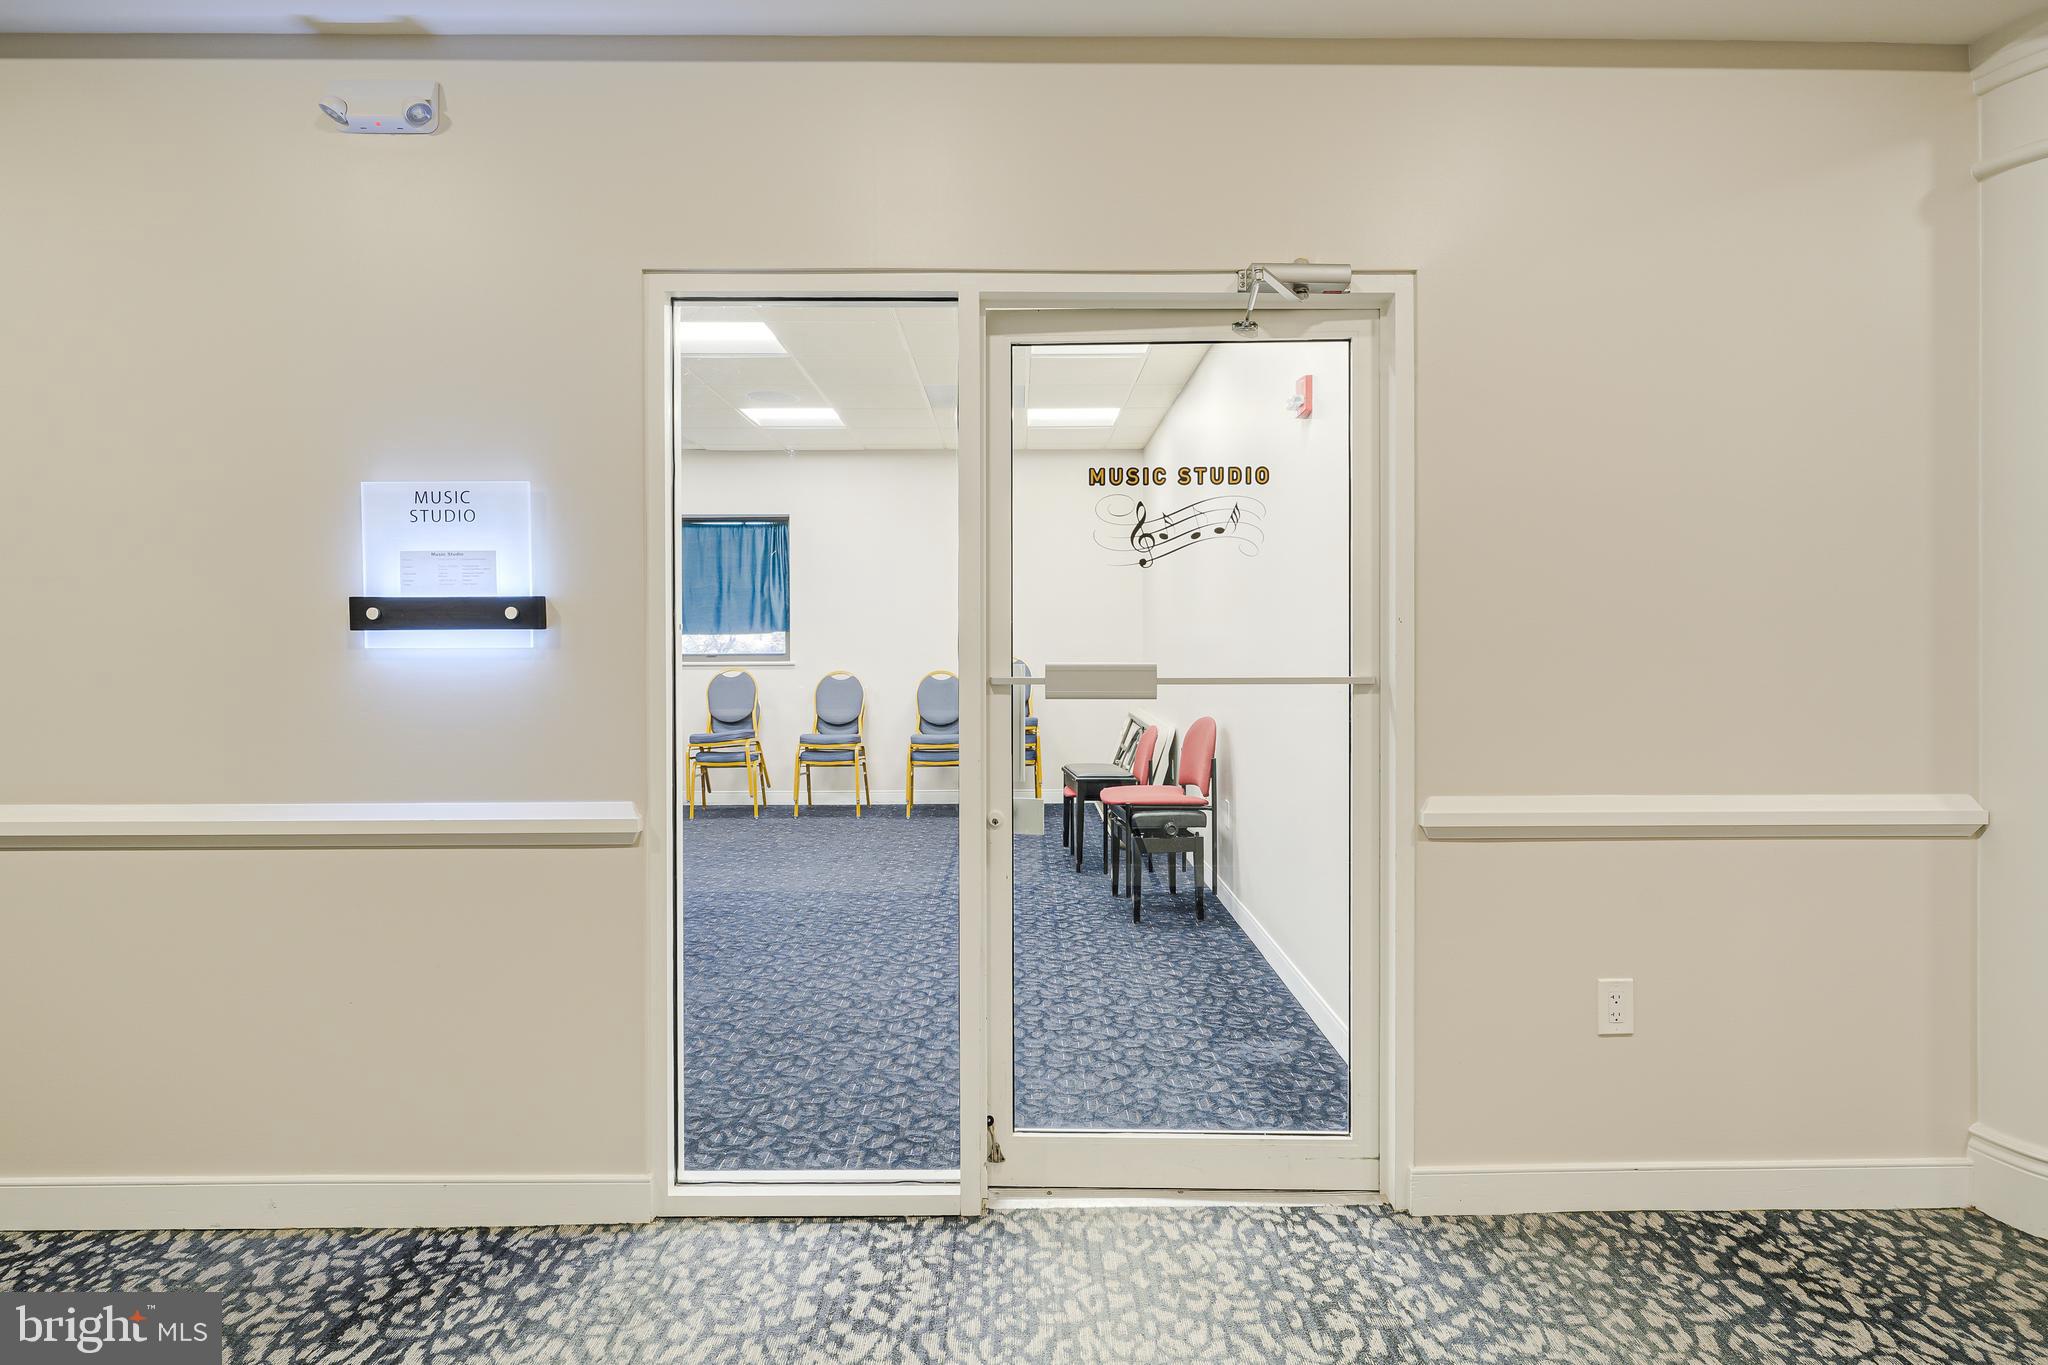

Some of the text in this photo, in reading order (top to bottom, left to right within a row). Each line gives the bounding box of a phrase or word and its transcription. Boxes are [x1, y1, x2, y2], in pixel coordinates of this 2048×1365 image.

[1088, 465, 1270, 487] MUSIC STUDIO
[414, 490, 470, 504] MUSIC
[409, 509, 476, 523] STUDIO
